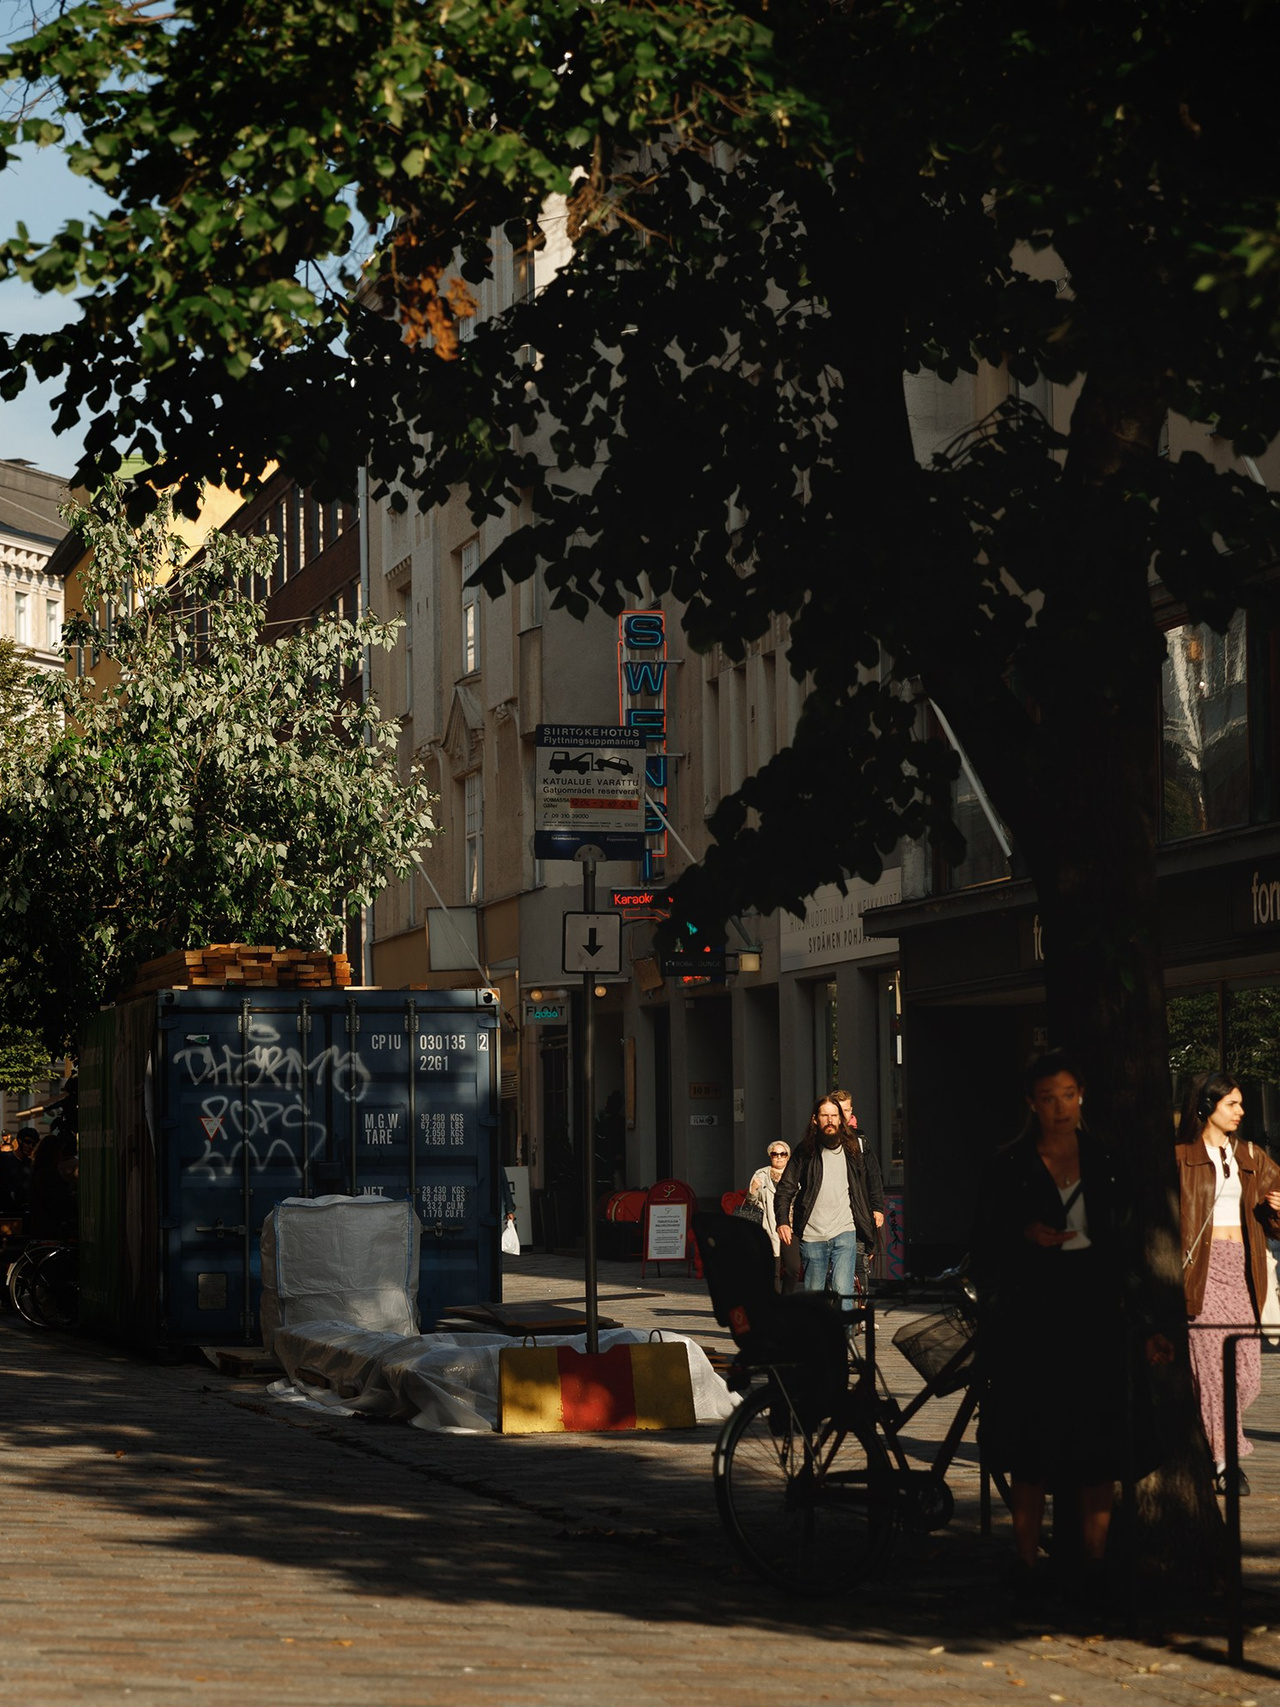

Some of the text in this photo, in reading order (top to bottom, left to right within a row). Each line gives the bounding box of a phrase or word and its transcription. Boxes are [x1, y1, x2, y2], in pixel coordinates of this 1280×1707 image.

[543, 727, 640, 737] SIIRTOKEHOTUS
[543, 736, 640, 746] Flyttningsuppmaning
[543, 778, 639, 787] KATUALUE VARATTU
[543, 786, 639, 795] Gatuområdet reserverat
[808, 931, 841, 953] SYDÄMEN
[371, 1034, 401, 1050] CPIU
[419, 1034, 466, 1050] 030135
[419, 1055, 449, 1071] 22G1
[364, 1113, 401, 1129] M.G.W.
[420, 1113, 464, 1122] 30.480 KGS
[420, 1121, 464, 1130] 67.200 LBS
[365, 1129, 393, 1145] TARE
[425, 1129, 464, 1138] 2.050 KGS
[425, 1137, 464, 1146] 4.520 LBS
[422, 1186, 466, 1194] 28.430 KGS
[422, 1194, 466, 1202] 62.680 LBS
[426, 1202, 442, 1210] 33.2
[422, 1210, 466, 1218] 1.170 CU.FT.
